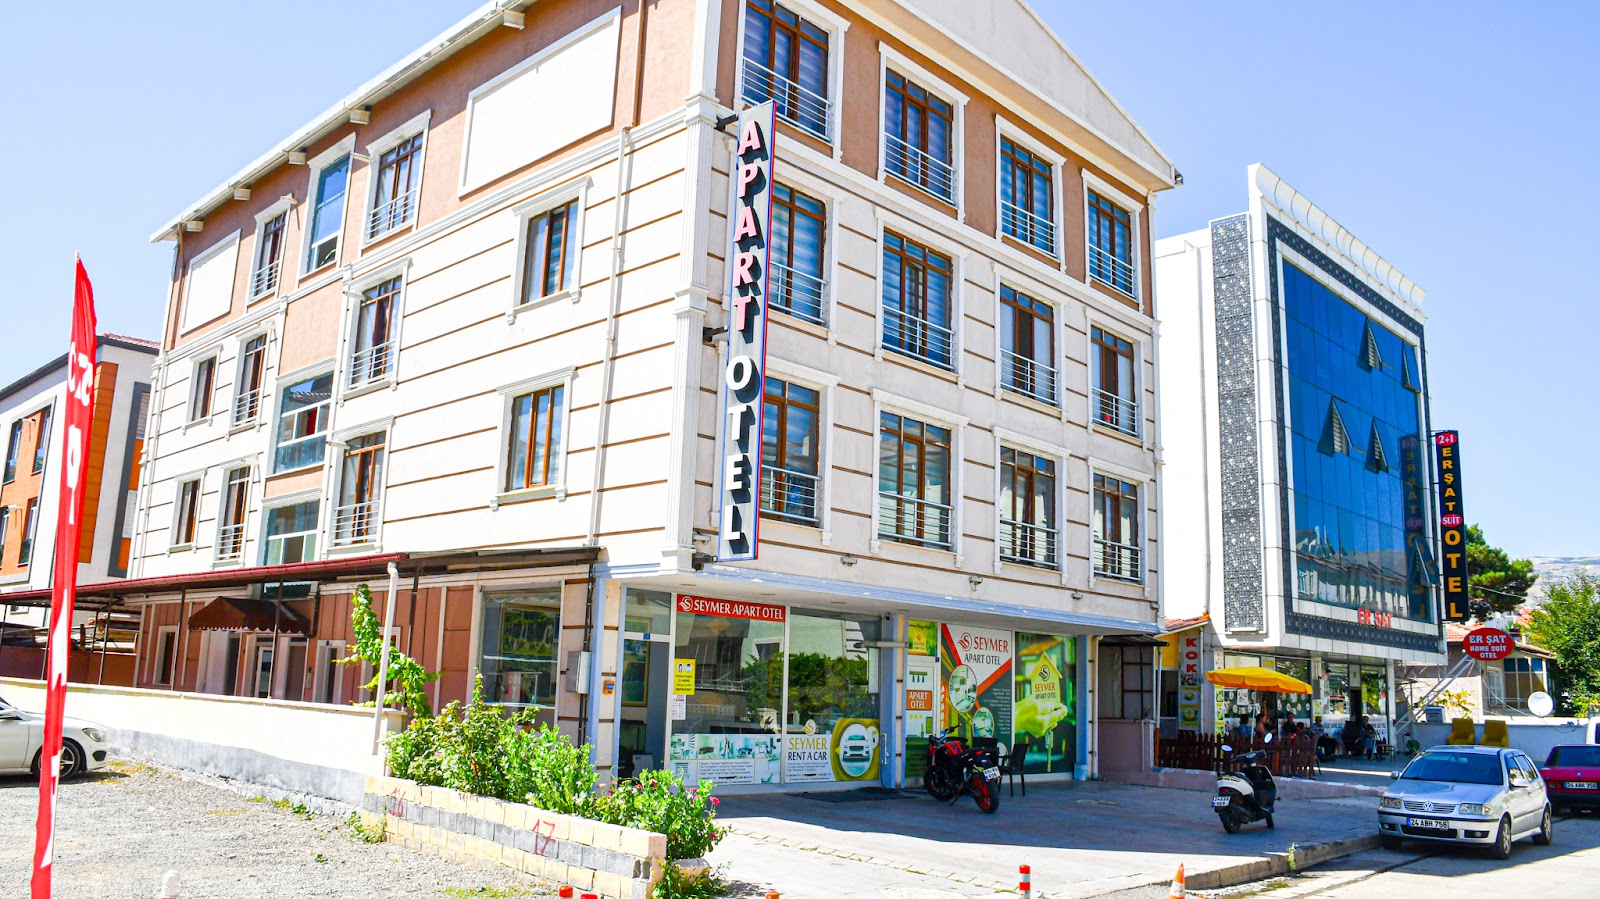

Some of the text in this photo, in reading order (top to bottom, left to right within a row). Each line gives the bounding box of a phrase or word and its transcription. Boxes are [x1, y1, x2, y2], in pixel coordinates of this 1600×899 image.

[732, 120, 765, 336] APART
[1438, 434, 1454, 445] 2+1
[723, 354, 757, 547] OTEL
[1442, 447, 1456, 512] ERŞAT
[1442, 514, 1461, 525] SUİT
[1444, 529, 1464, 618] OTEL
[694, 599, 731, 614] SEYMER
[732, 604, 761, 618] APART
[762, 607, 783, 620] OTEL
[1357, 607, 1393, 629] ER ŞAT
[973, 636, 1009, 653] SEYMER
[1469, 635, 1507, 646] ER ŞAT
[964, 653, 1001, 666] APART OTEL
[1035, 682, 1056, 692] SEYMER
[908, 691, 929, 701] APART
[1035, 691, 1057, 700] APART OTEL
[910, 700, 926, 709] OTEL
[789, 737, 828, 750] SEYMER
[787, 751, 828, 761] RENT A CAR
[1411, 818, 1419, 826] 24
[1420, 819, 1433, 827] ABH
[531, 818, 556, 856] 17
